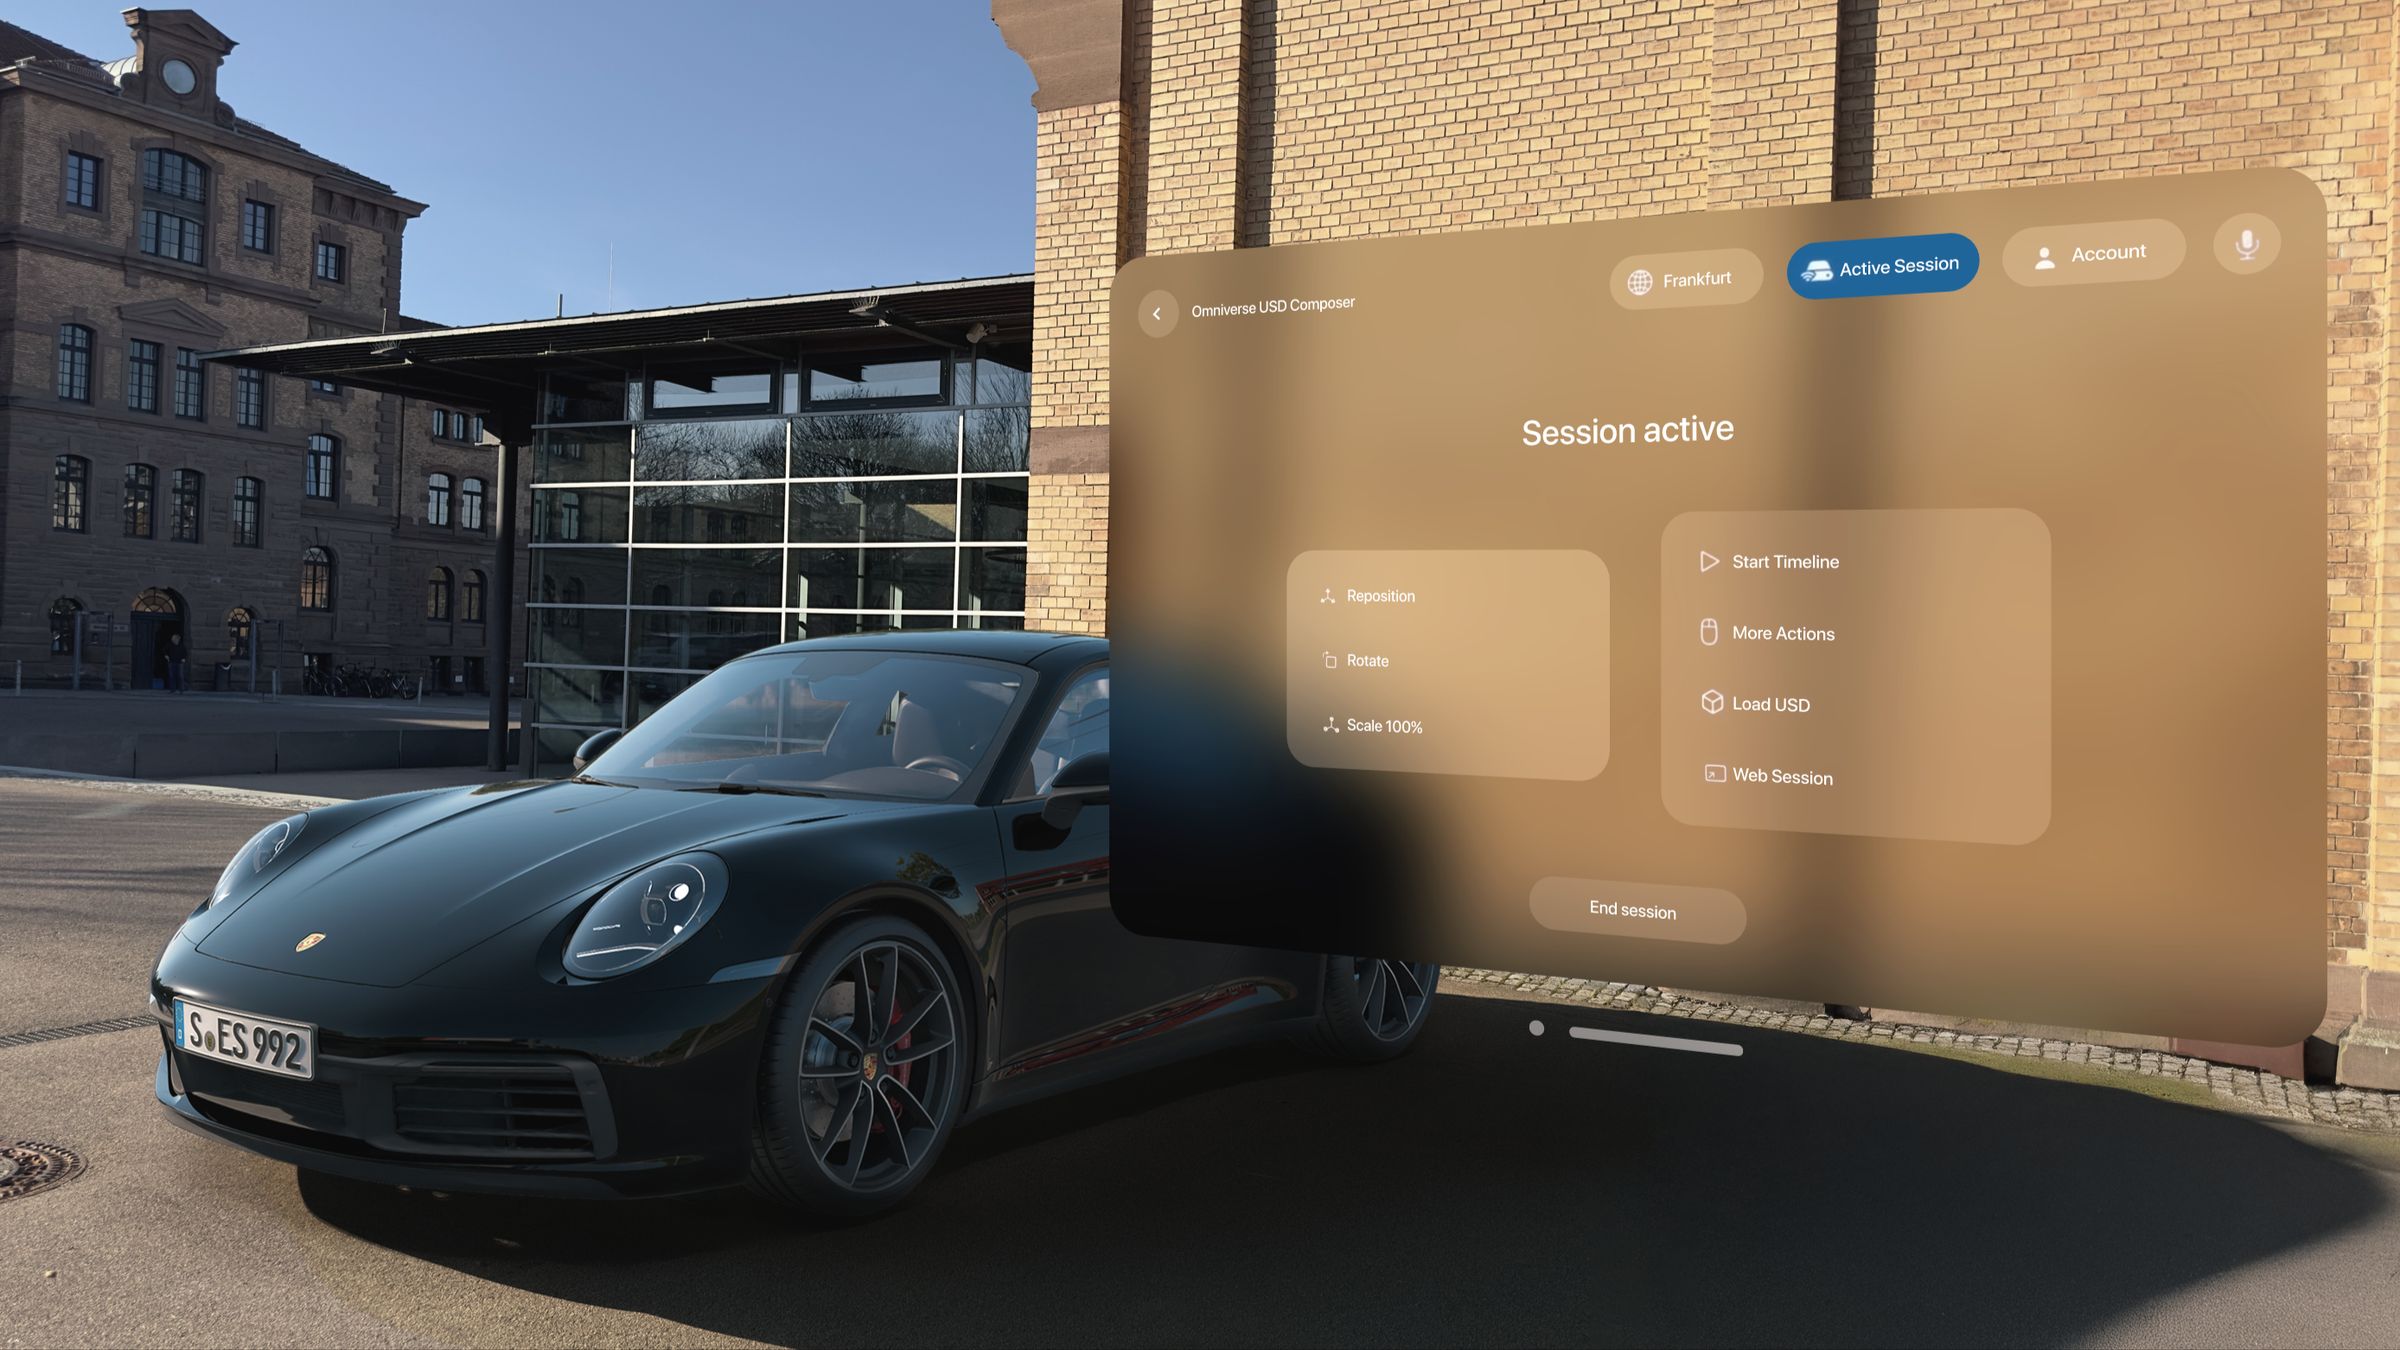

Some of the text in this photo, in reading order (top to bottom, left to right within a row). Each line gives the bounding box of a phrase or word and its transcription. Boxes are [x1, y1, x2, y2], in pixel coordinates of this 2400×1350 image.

[2071, 243, 2147, 263] Account
[1839, 256, 1960, 279] Active Session
[1663, 271, 1732, 289] Frankfurt
[1191, 294, 1356, 318] Omniverse USD Composer
[1522, 414, 1735, 447] Session active
[1732, 554, 1840, 569] Start Timeline
[1347, 587, 1416, 605] Reposition
[1733, 625, 1836, 642] More Actions
[1347, 653, 1389, 668] Rotate
[1732, 695, 1811, 713] Load USD
[1347, 718, 1423, 735] Scale 100%
[1732, 767, 1834, 787] Web Session
[1590, 899, 1677, 921] End session
[252, 1026, 303, 1070] 992
